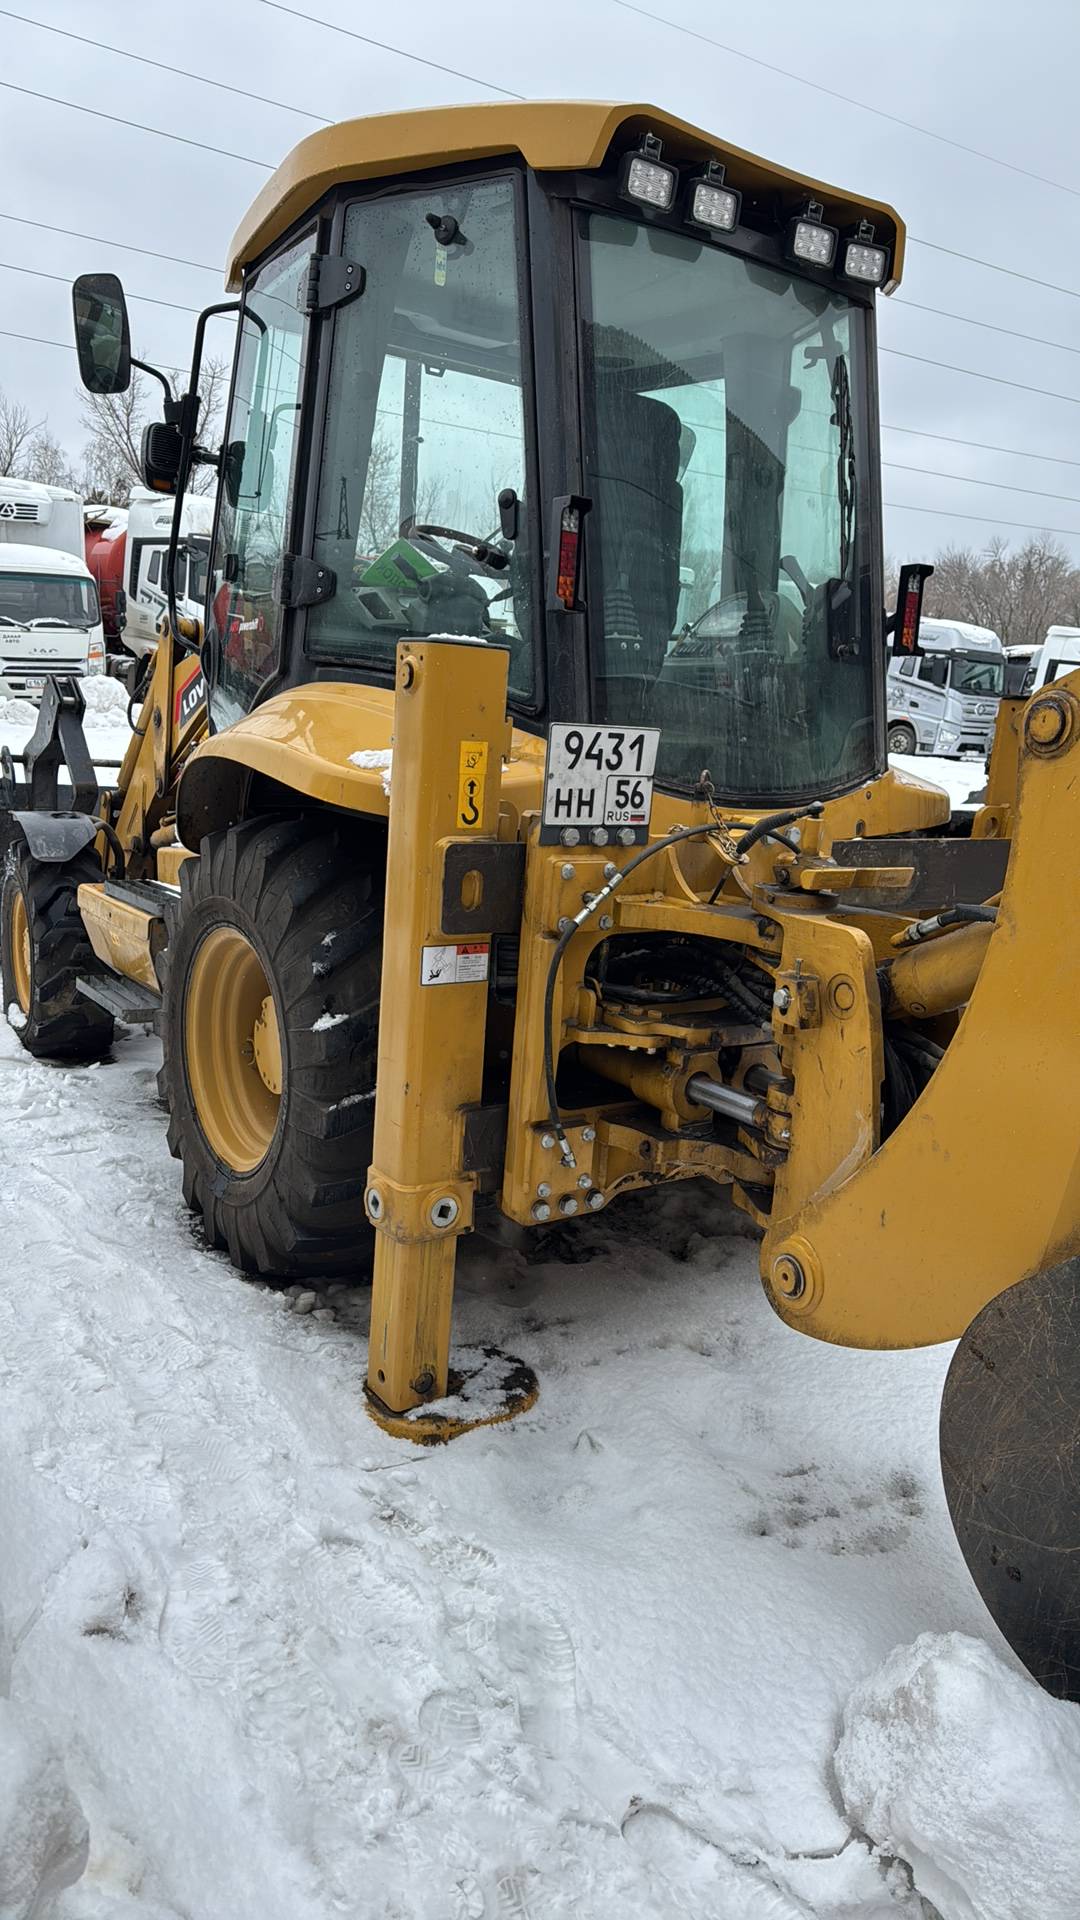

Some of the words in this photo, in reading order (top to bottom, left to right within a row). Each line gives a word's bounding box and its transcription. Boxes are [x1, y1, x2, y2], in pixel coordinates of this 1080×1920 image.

[183, 678, 204, 715] LOV
[565, 730, 645, 772] 9431
[615, 780, 645, 809] 56
[606, 811, 630, 822] RUS
